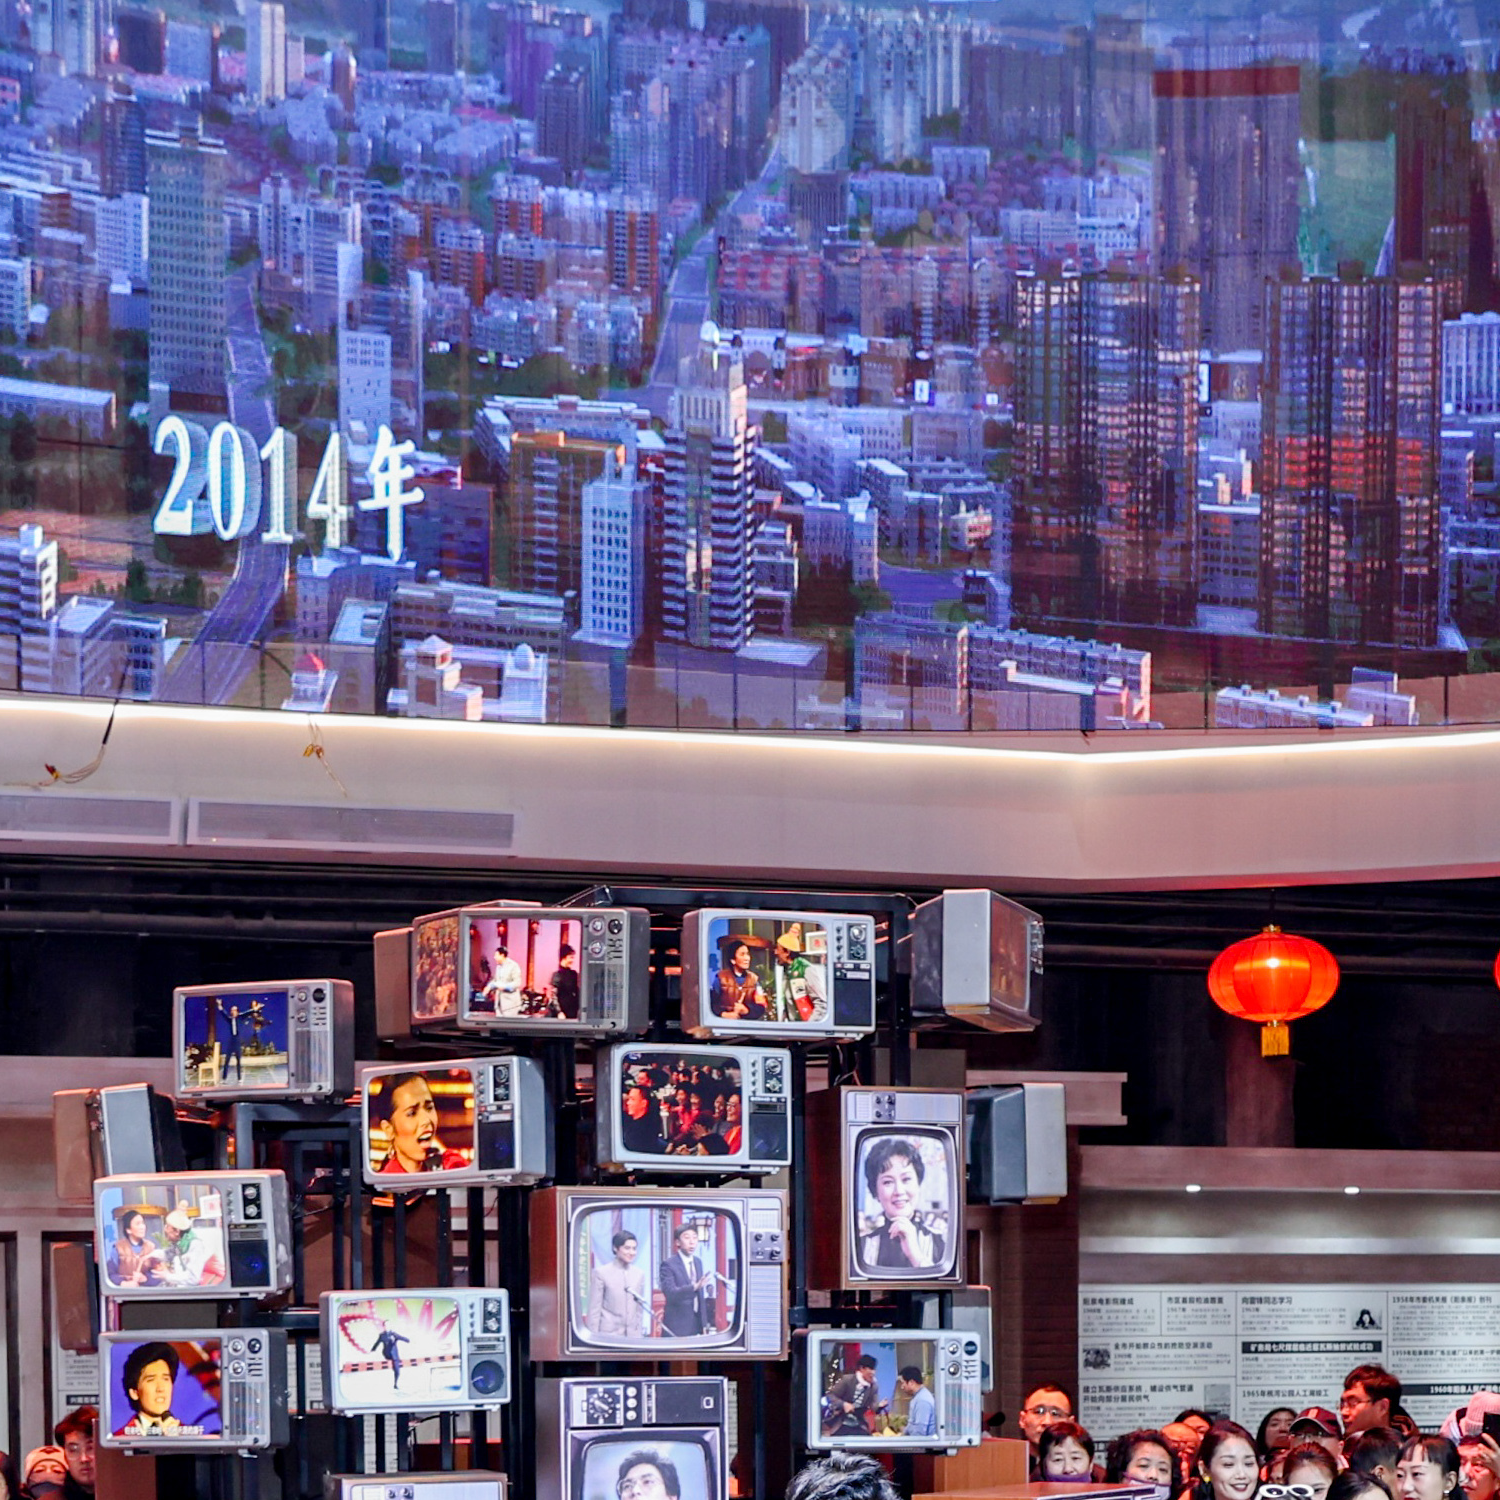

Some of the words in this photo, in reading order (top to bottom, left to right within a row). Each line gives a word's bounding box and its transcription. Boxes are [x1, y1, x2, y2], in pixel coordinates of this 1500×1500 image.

[153, 414, 425, 563] 2014年
[1241, 1296, 1292, 1305] 向雷锋同志学习
